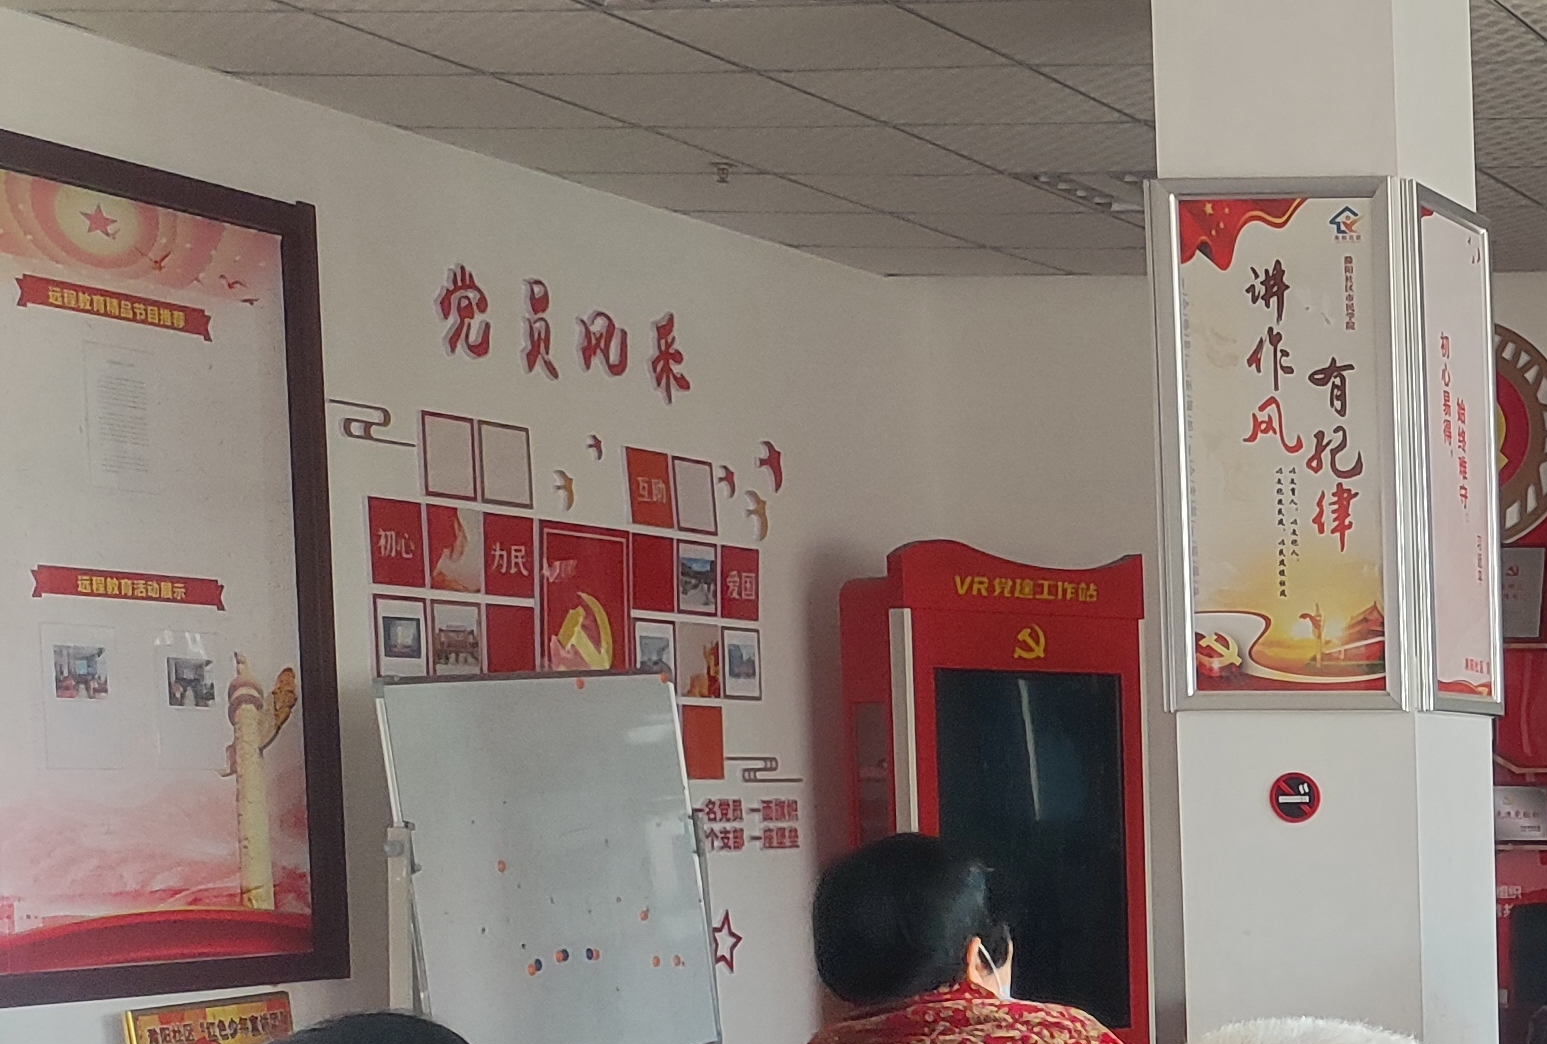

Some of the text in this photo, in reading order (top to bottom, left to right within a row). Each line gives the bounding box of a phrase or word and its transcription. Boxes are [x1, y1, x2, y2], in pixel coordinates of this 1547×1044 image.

[48, 286, 187, 329] 远程教育精品节目推荐
[437, 263, 691, 405] 党员风采
[1243, 259, 1304, 454] 讲作风
[1306, 356, 1365, 553] 有纪律
[636, 476, 668, 505] 互助
[375, 528, 415, 560] 初心
[490, 543, 530, 577] 为民
[77, 574, 187, 600] 远程教育活动展示
[725, 570, 757, 601] 爱国
